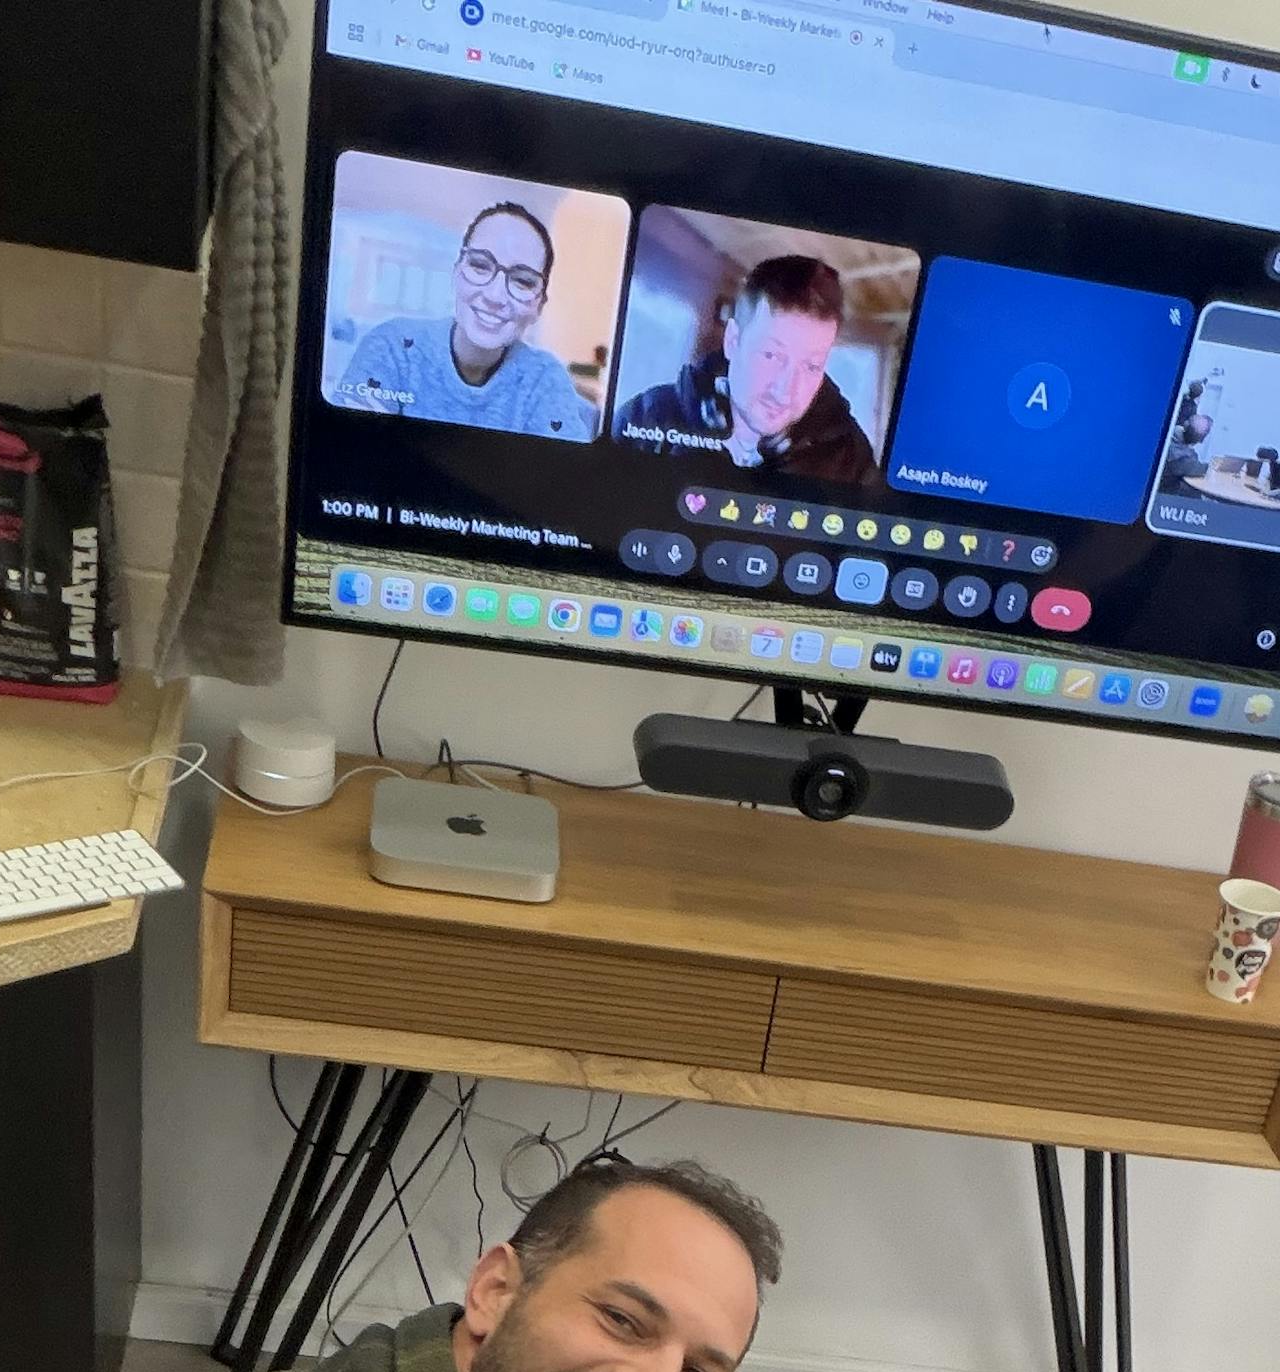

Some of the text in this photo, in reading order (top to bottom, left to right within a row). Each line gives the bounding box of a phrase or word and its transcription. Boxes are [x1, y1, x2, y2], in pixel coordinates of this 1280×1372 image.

[741, 9, 797, 33] Bi-Weekly
[927, 8, 955, 24] Help
[416, 38, 450, 55] Gmail
[488, 50, 536, 72] YouTube
[573, 66, 604, 84] Maps
[356, 382, 416, 404] Greaves
[1025, 381, 1049, 411] A
[622, 422, 723, 452] Jacob Greaves
[897, 464, 989, 495] Asaph Boskey
[322, 499, 353, 517] 1:00
[355, 503, 380, 520] PM
[400, 510, 470, 535] Bi-Weekly
[471, 519, 540, 545] Marketing
[541, 529, 579, 548] Team
[1184, 510, 1208, 527] Bot
[61, 526, 99, 658] LAVAZZA
[762, 637, 772, 652] 7
